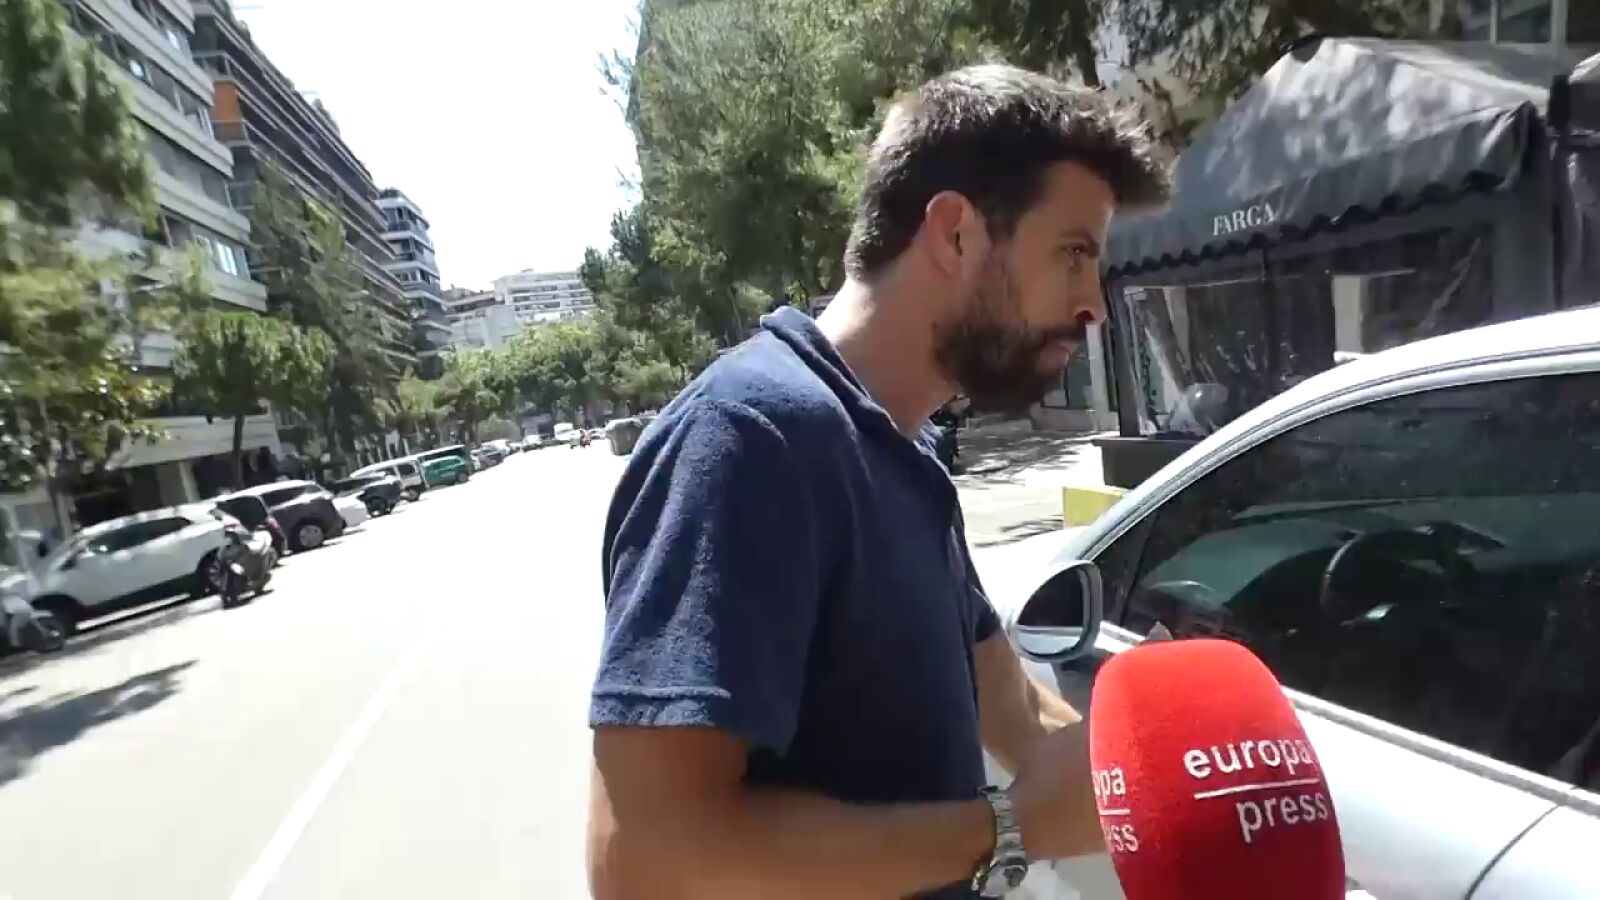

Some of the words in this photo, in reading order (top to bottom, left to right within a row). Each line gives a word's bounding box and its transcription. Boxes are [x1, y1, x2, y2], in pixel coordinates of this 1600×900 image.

[1213, 203, 1274, 235] FARGA
[1183, 739, 1314, 778] europa
[1236, 792, 1328, 843] press
